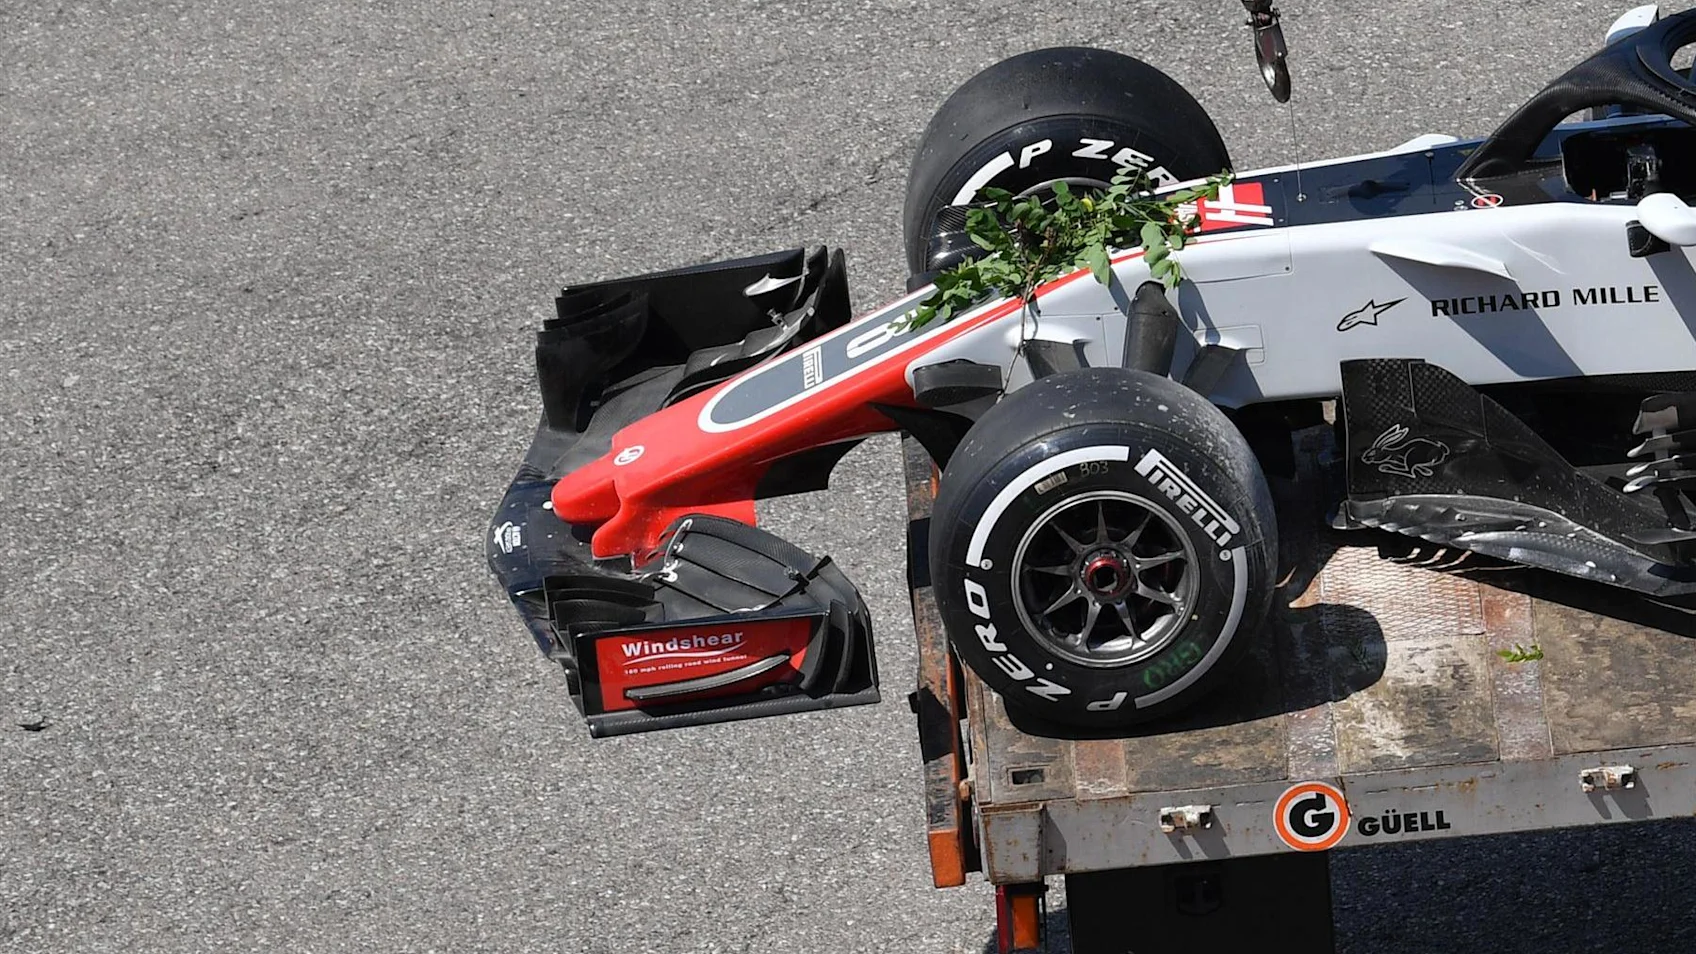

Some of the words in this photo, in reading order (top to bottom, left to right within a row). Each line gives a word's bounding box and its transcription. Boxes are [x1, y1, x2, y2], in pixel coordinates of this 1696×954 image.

[1018, 138, 1053, 169] P
[1072, 137, 1181, 188] ZER
[1431, 289, 1561, 318] RICHARD
[1572, 285, 1661, 306] MILLE
[802, 345, 823, 390] PIRELLI
[1133, 447, 1240, 547] PIRELLI
[621, 631, 744, 658] Windshear
[964, 578, 1072, 702] ZERO
[1086, 691, 1128, 711] P
[1357, 808, 1451, 837] GÜELL
